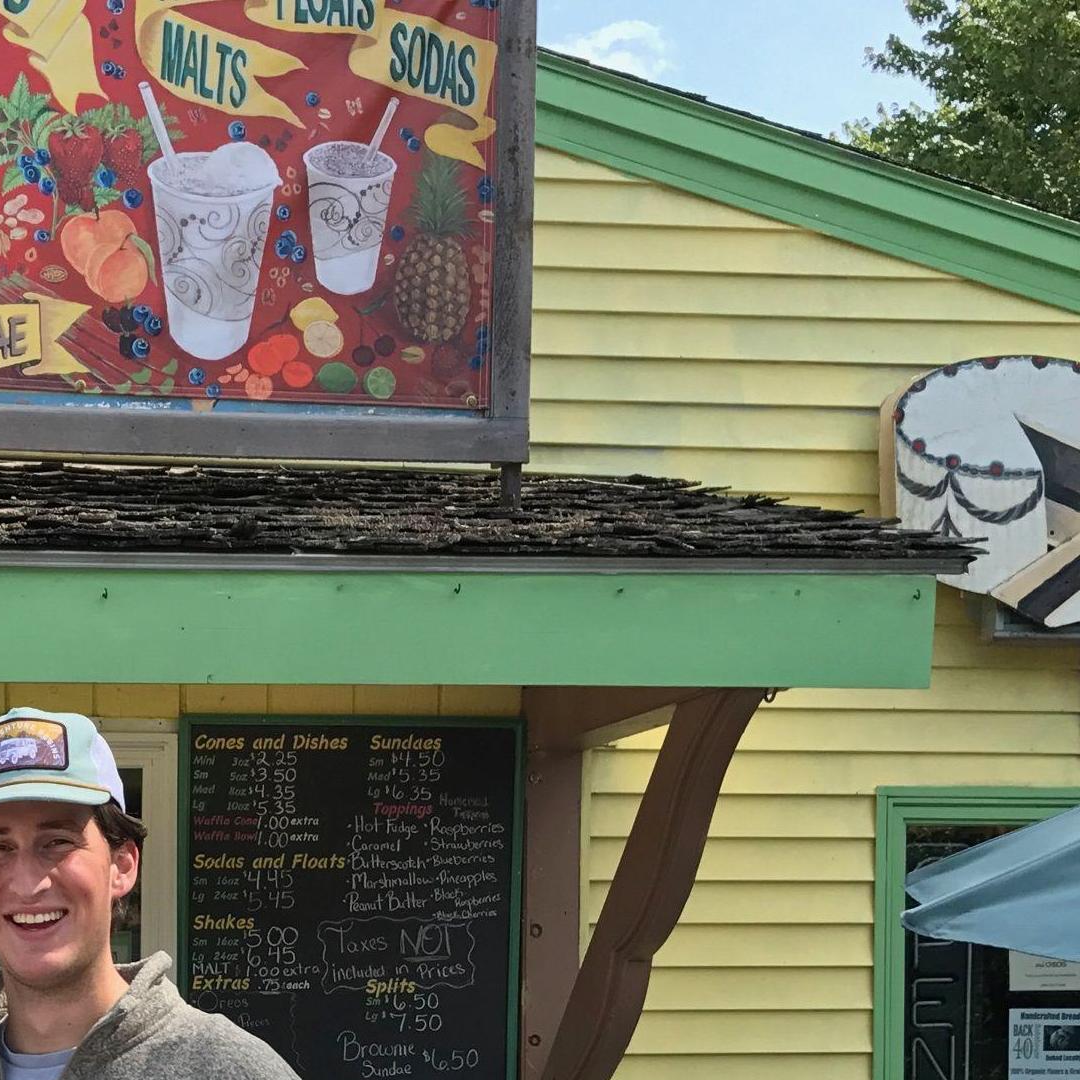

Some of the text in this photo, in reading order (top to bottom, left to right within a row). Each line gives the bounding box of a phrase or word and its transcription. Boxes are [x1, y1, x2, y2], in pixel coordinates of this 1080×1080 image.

[160, 19, 247, 108] MALTS
[390, 22, 476, 106] SODAS
[194, 733, 349, 750] Cones and Dishes
[370, 733, 442, 750] Sundaes
[373, 801, 433, 819] Toppings
[354, 815, 419, 840] Hot Fudge
[430, 816, 505, 841] Raspberries
[351, 834, 401, 852] Caramel
[430, 837, 505, 851] Strawberries
[193, 853, 346, 869] Sodas and Floats
[348, 851, 426, 871] Butterscotch
[431, 855, 496, 868] Blueberries
[351, 871, 433, 890] Marshmallow
[345, 891, 426, 913] Peanut Butter
[193, 913, 255, 930] Shakes
[325, 921, 466, 956] Taxes NOT
[332, 963, 466, 983] included in Prices
[192, 975, 251, 991] Extras
[286, 980, 310, 991] each
[365, 978, 416, 997] Splits
[1013, 1024, 1033, 1037] BACK
[336, 1030, 416, 1062] Brownie
[1013, 1037, 1033, 1060] 40
[361, 1060, 413, 1078] Sundae
